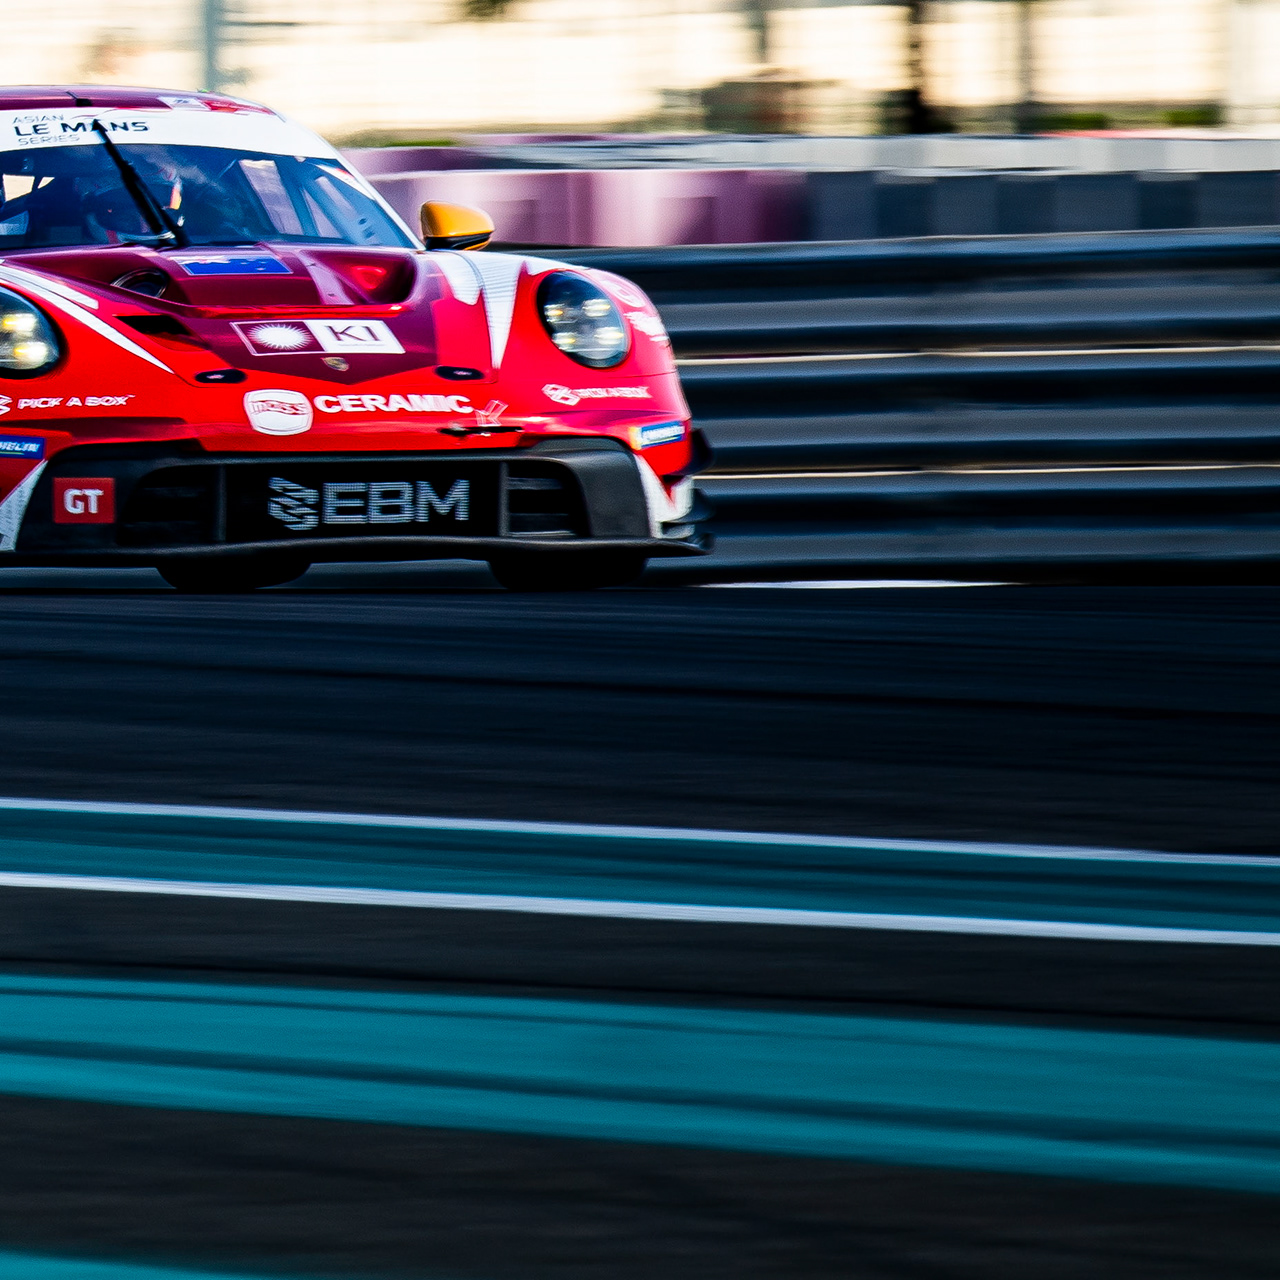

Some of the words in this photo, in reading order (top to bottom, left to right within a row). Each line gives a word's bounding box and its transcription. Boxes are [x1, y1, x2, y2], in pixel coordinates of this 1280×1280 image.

[12, 114, 65, 124] ASIAN
[14, 123, 49, 137] LE
[17, 134, 81, 146] SERIES
[324, 325, 382, 342] KI
[17, 397, 64, 410] PICK
[66, 396, 83, 407] A
[84, 395, 129, 407] BOX
[313, 393, 476, 414] CERAMIC
[63, 488, 105, 515] GT
[322, 478, 471, 525] EBM
